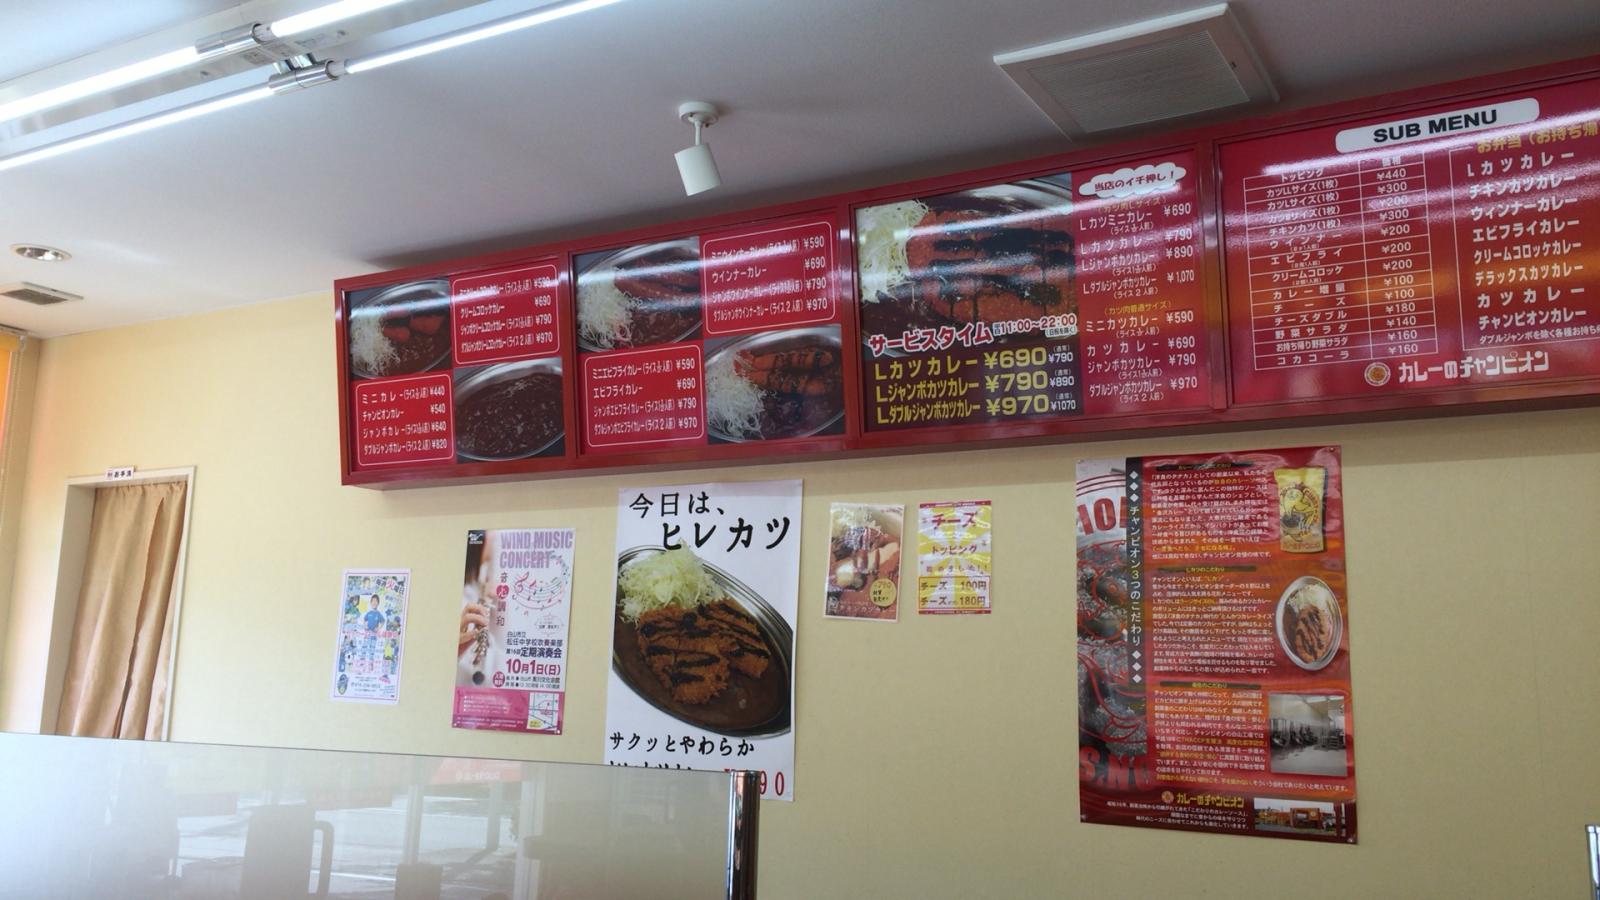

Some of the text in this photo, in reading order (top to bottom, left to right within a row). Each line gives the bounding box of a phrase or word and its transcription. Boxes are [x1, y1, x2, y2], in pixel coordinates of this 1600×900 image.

[1373, 109, 1498, 144] SUB MENU
[1377, 168, 1407, 181] ¥440
[1377, 181, 1408, 194] ¥300
[1469, 174, 1577, 200] チキンカツカレー
[1080, 203, 1191, 231] Lカツミニカレー ¥690
[1380, 208, 1409, 222] ¥300
[1380, 224, 1410, 237] ¥200
[1473, 218, 1580, 242] エビフライカレー
[803, 236, 825, 249] ¥590
[1080, 228, 1192, 255] Lカツカレー ¥790
[1473, 239, 1582, 265] クリームコロッケカレー
[804, 256, 826, 270] ¥690
[1082, 252, 1155, 271] Lジャンボカツカレー
[1165, 245, 1193, 259] ¥890
[1271, 241, 1411, 266] エビフライ ¥200
[1272, 259, 1412, 282] クリームコロッケ ¥200
[1384, 275, 1414, 287] ¥100
[1475, 262, 1584, 287] デラックスカツカレー
[806, 277, 827, 291] ¥790
[534, 295, 551, 307] ¥690
[806, 297, 828, 311] ¥970
[1274, 288, 1415, 314] チーズ ¥100
[1477, 286, 1585, 309] カツカレー
[535, 313, 552, 325] ¥790
[1086, 310, 1194, 332] ミニカツカレー ¥590
[1274, 302, 1416, 327] チーズダブル ¥180
[1478, 307, 1587, 331] チャンピオンカレー
[536, 331, 553, 344] ¥970
[1275, 316, 1416, 339] 野菜サラダ ¥140
[1388, 330, 1418, 342] ¥160
[868, 322, 993, 357] サービスタイム
[1087, 335, 1195, 357] カツカレー ¥690
[675, 358, 695, 371] ¥590
[875, 347, 1073, 380] Lカツカレー ¥690 ¥790
[1088, 352, 1196, 374] ジャンボカツカレー ¥790
[1277, 344, 1418, 365] コカコーラ ¥160
[1398, 351, 1549, 384] カレーのチャンピオン
[593, 377, 696, 399] エビフライカレー ¥690
[876, 370, 1074, 402] Lジャンボカツカレー ¥790 ¥890
[1089, 376, 1198, 398] ダブルジャンボカツカレー ¥970
[430, 403, 446, 415] ¥540
[678, 397, 697, 410] ¥790
[877, 394, 1076, 424] Lダブルジャンボカツカレー ¥970 ¥1070
[678, 416, 698, 429] ¥970
[932, 511, 978, 530] チーズ
[500, 530, 573, 550] WIND MUSIC
[662, 516, 792, 554] ヒレカツ
[499, 550, 551, 569] CONCERT
[932, 544, 978, 555] トッピング
[921, 580, 987, 591] チーズ 100円
[959, 596, 985, 606] 180円
[506, 658, 561, 676] 10月1日(日)
[610, 731, 755, 757] サクッとやわらか
